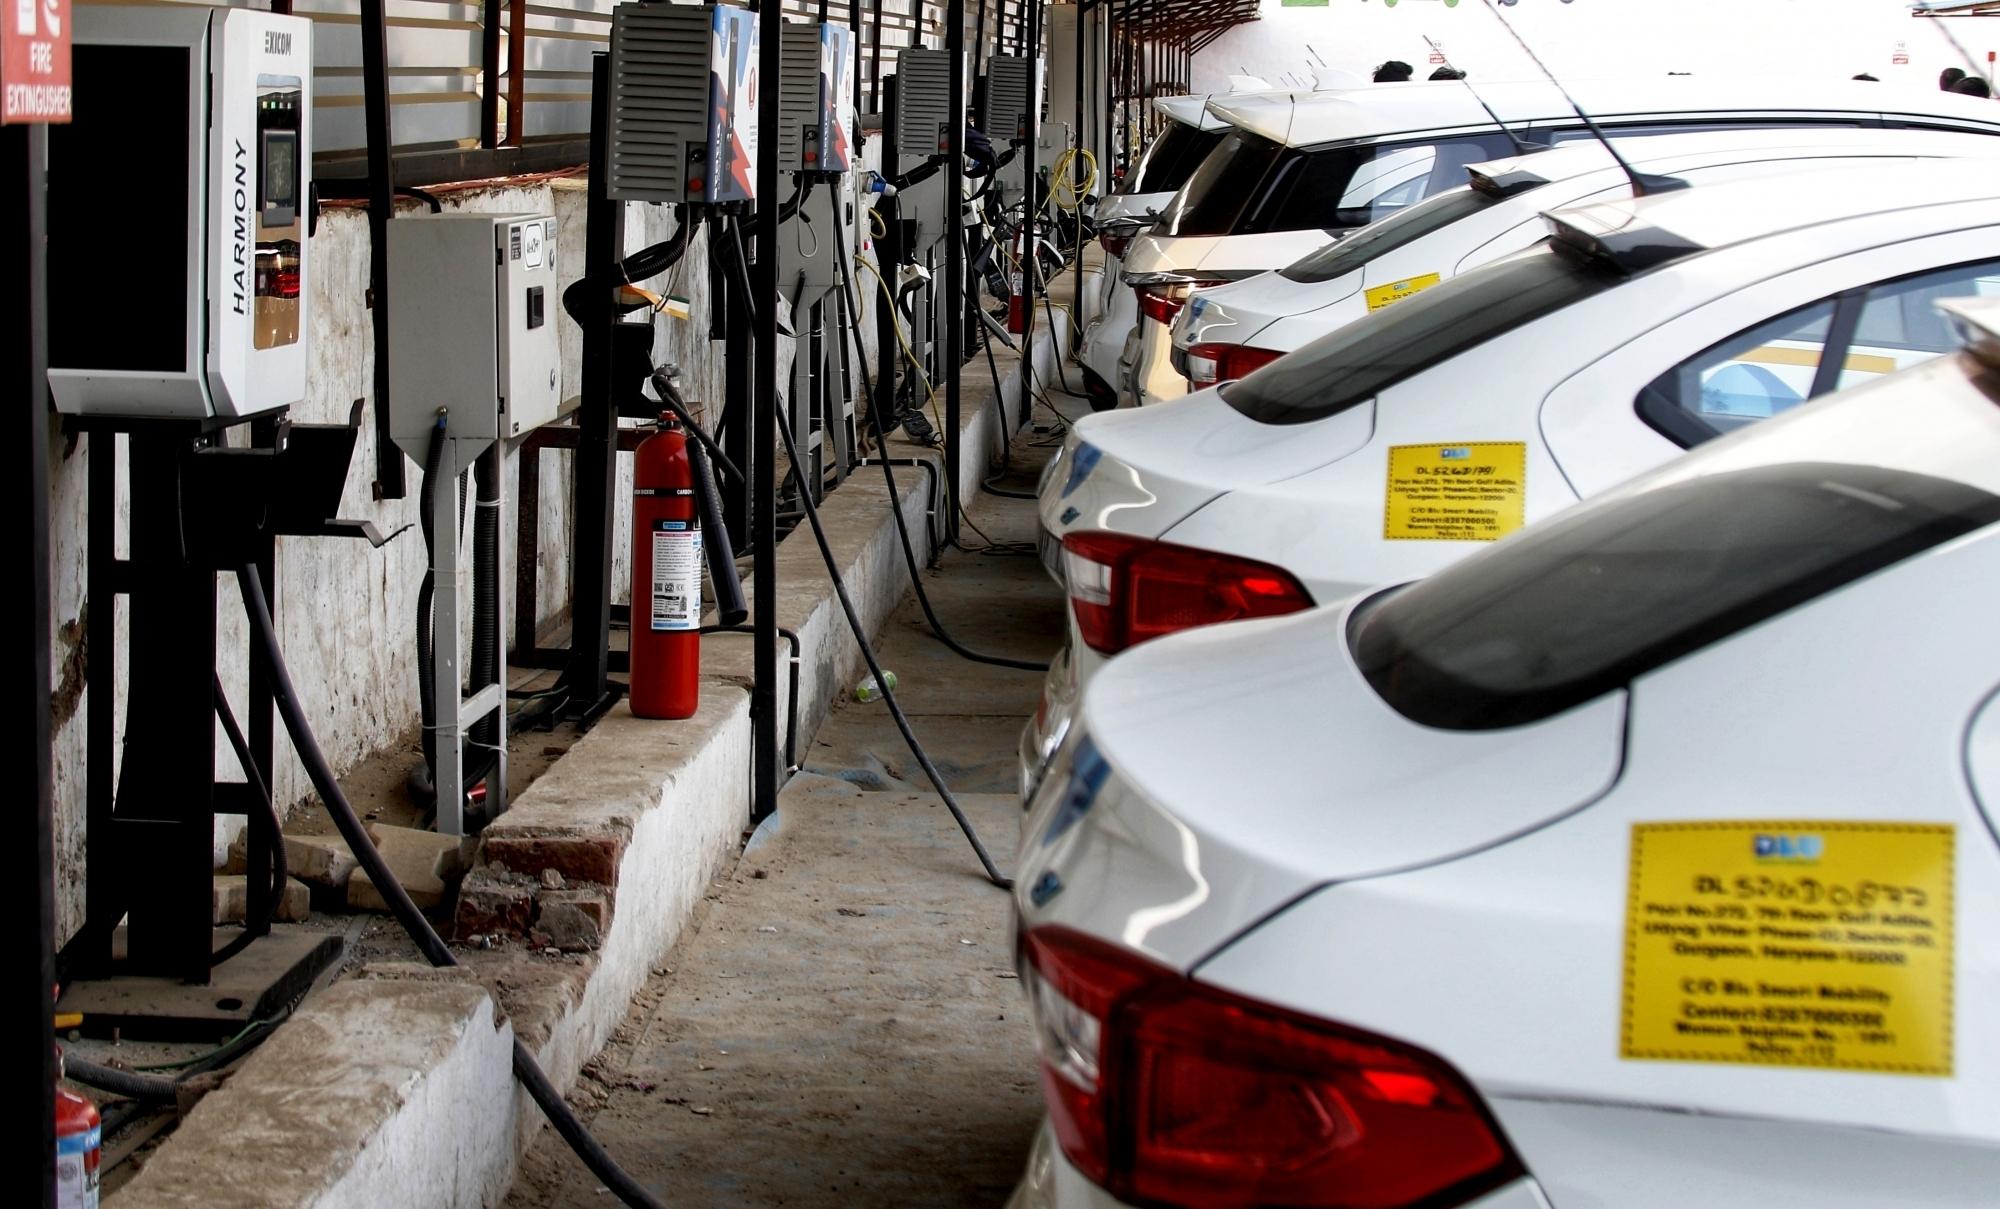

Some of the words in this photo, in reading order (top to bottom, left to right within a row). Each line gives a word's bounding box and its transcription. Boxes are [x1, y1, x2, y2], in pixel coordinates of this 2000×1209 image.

[264, 30, 292, 57] EXICOM
[30, 41, 53, 75] FIRE
[233, 137, 247, 316] HARMONY
[1417, 466, 1431, 475] DL
[1693, 874, 1728, 896] DL
[1756, 979, 1813, 999] Smart
[1816, 983, 1893, 1008] Mobility
